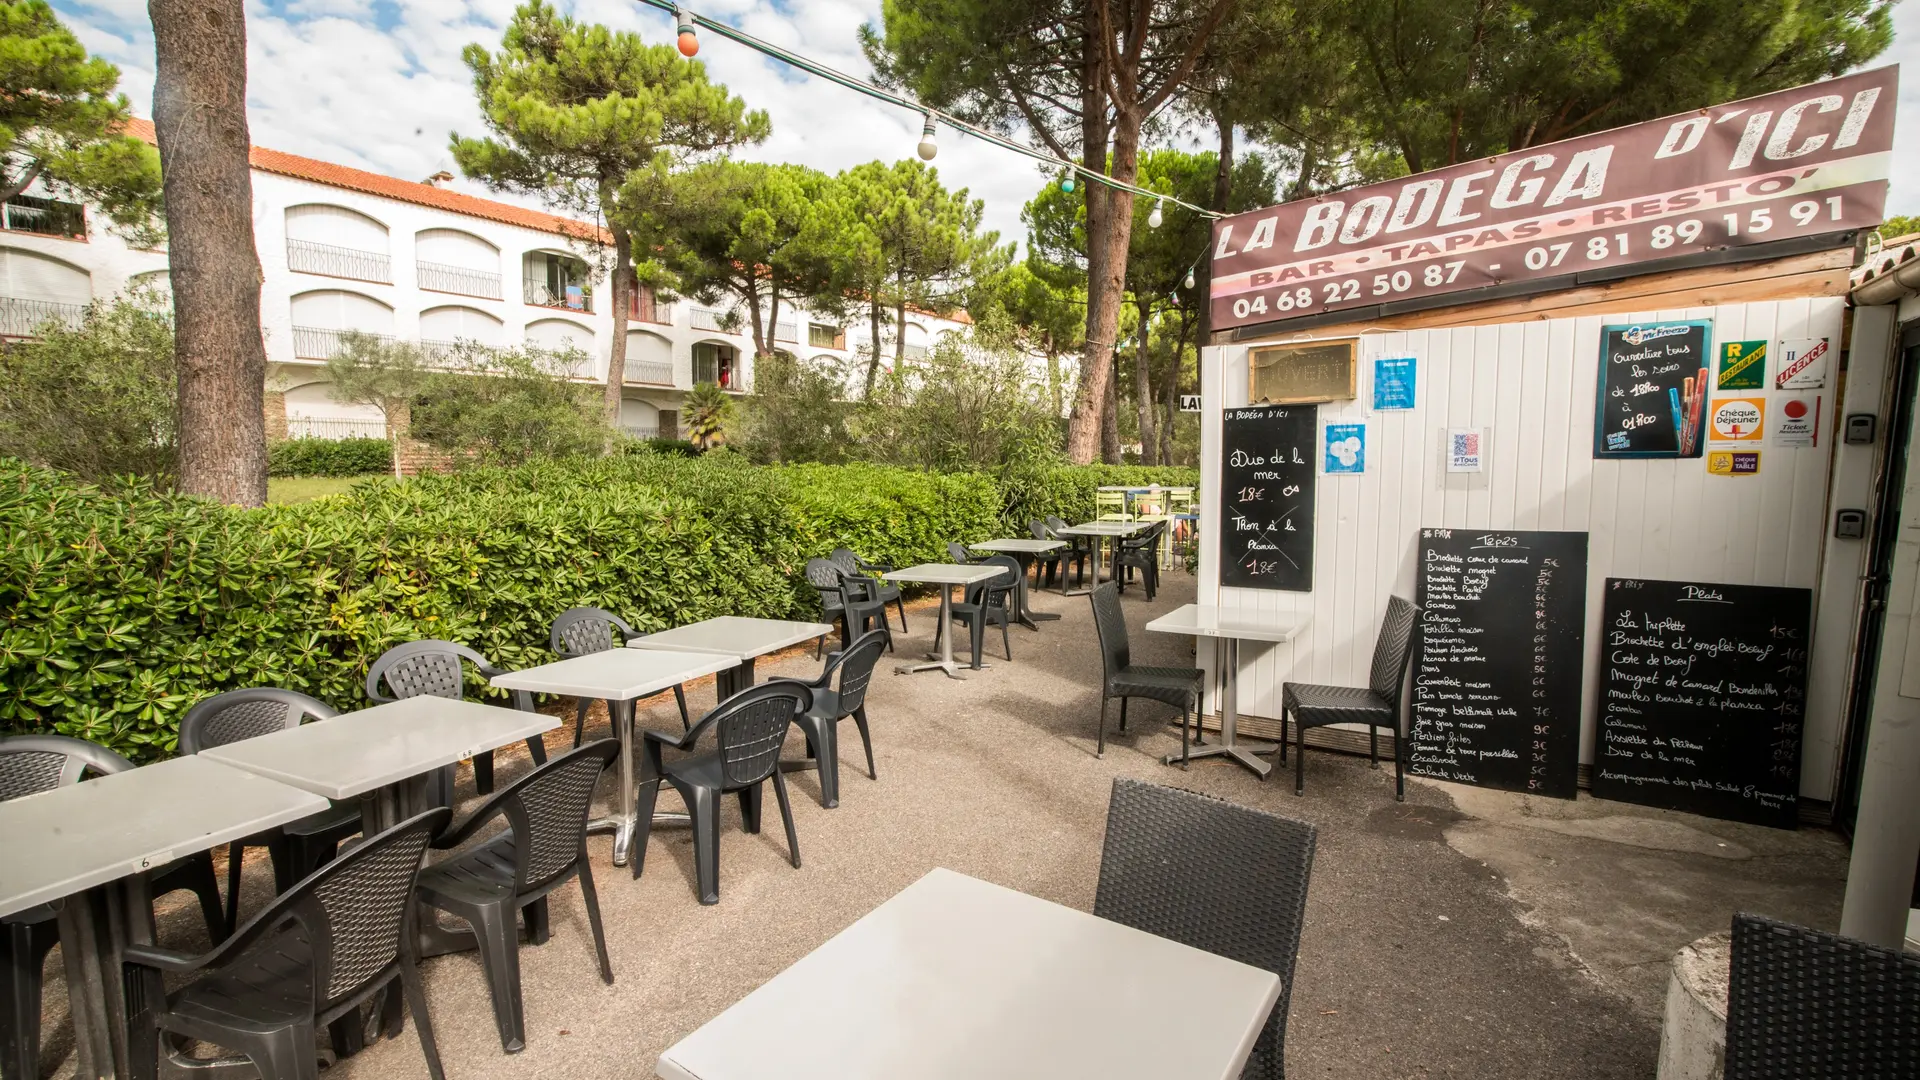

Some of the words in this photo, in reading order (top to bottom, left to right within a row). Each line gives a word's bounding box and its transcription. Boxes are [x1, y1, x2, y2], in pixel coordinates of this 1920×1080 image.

[1213, 216, 1278, 260] LA
[1293, 145, 1614, 252] BODEGA
[1654, 87, 1881, 170] D'ICI
[1233, 295, 1268, 319] 04
[1276, 287, 1313, 312] 68
[1322, 279, 1361, 304] 22
[1372, 270, 1412, 296] 50
[1423, 260, 1466, 287] 87
[1524, 241, 1573, 271] 07
[1586, 233, 1629, 261] 81
[1651, 219, 1704, 250] 89
[1723, 207, 1775, 237] 15
[1789, 195, 1843, 227] 91
[1250, 260, 1335, 287] BAR
[1382, 221, 1541, 261] TAPAS
[1666, 344, 1691, 356] tous
[1727, 343, 1742, 357] R
[1719, 345, 1766, 384] RESTAURANT
[1779, 342, 1825, 383] LICENCE
[1631, 364, 1647, 378] les
[1611, 386, 1625, 397] de
[1224, 412, 1233, 421] LA
[1716, 416, 1759, 425] Déjeuner
[1719, 409, 1756, 419] Chèque
[1230, 449, 1265, 467] Duo
[1270, 449, 1285, 464] de
[1292, 447, 1305, 465] la
[1253, 471, 1281, 480] mer
[1237, 486, 1265, 502] 18€
[1231, 515, 1261, 531] Thon
[1266, 519, 1278, 531] à
[1284, 518, 1297, 531] la
[1246, 559, 1278, 575] 18€
[1488, 555, 1499, 563] de
[1616, 610, 1638, 628] La
[1610, 631, 1664, 648] Brochette
[1647, 653, 1659, 665] de
[1665, 675, 1678, 687] de
[1682, 680, 1723, 694] canard
[1605, 730, 1648, 746] Assiette
[1653, 736, 1667, 746] du
[1605, 745, 1634, 758] Duo
[1641, 748, 1653, 759] de
[1659, 751, 1669, 762] la
[1673, 756, 1696, 766] mer
[142, 857, 150, 868] 6
